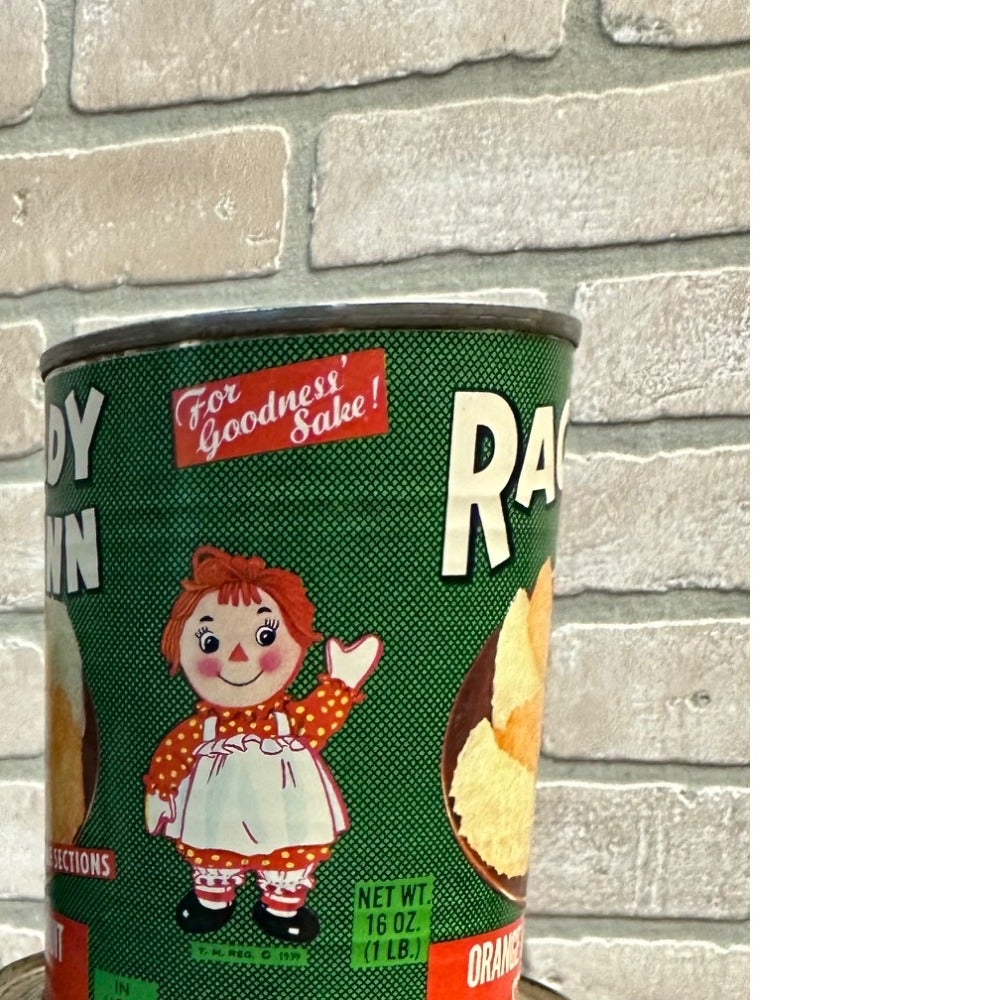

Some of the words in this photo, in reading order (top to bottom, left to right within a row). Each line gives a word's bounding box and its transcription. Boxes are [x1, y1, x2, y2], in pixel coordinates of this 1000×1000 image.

[175, 383, 241, 430] For
[53, 848, 111, 877] SECTIONS
[358, 885, 395, 909] NET
[401, 883, 431, 906] WT.
[367, 913, 387, 936] 16
[393, 911, 421, 933] OZ.
[364, 940, 379, 963] (1
[387, 937, 421, 961] LB.)
[115, 981, 129, 996] IN
